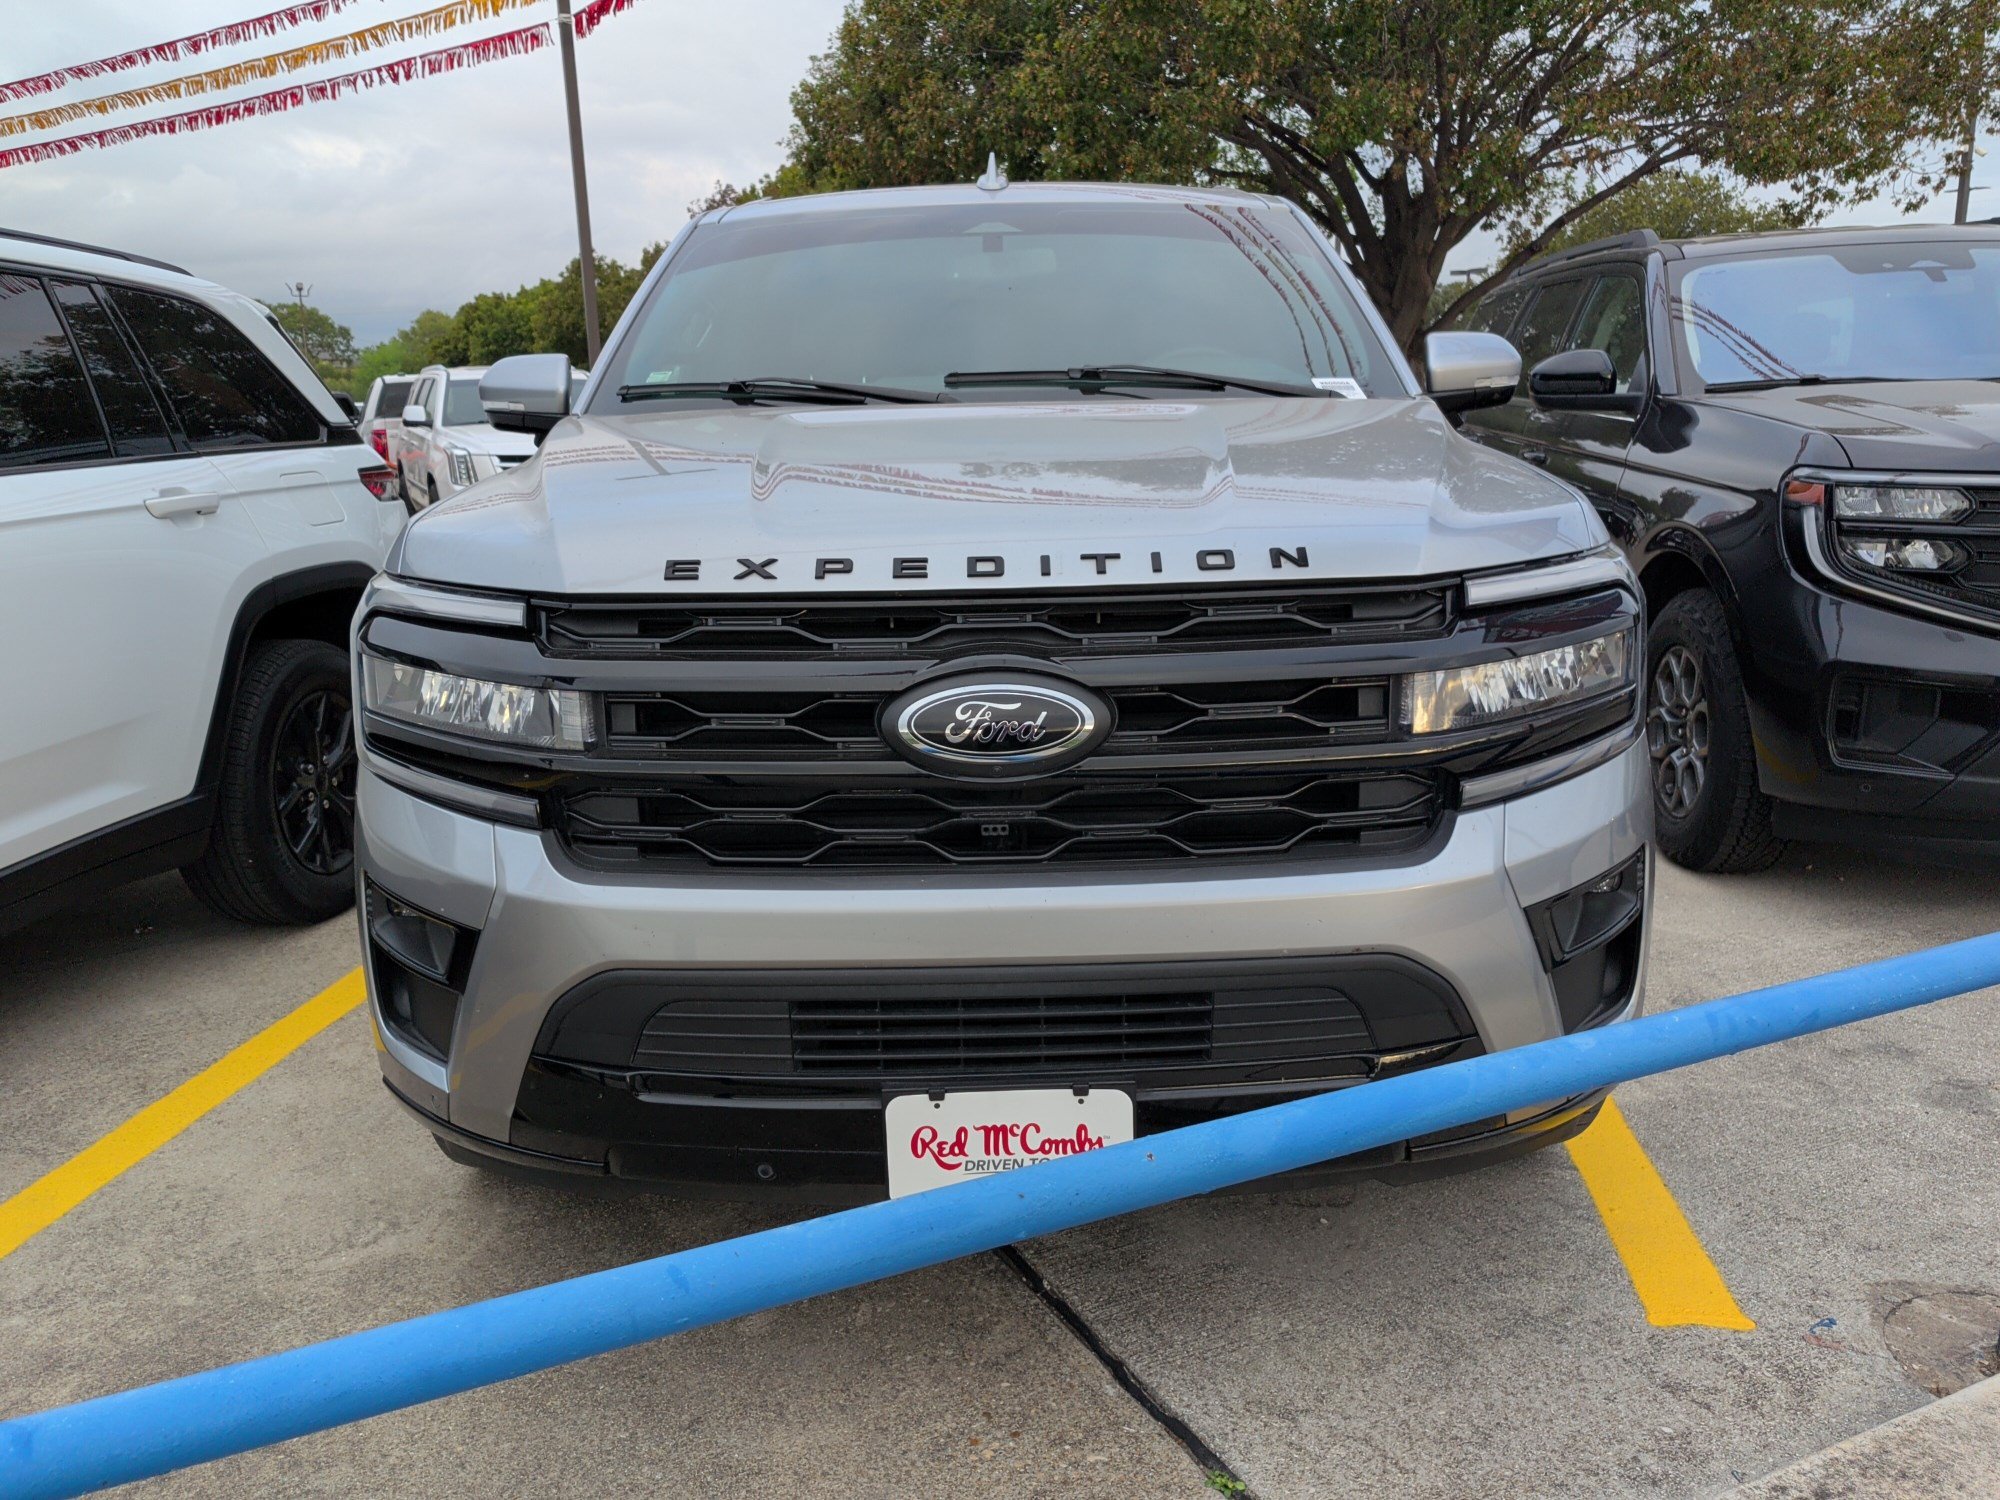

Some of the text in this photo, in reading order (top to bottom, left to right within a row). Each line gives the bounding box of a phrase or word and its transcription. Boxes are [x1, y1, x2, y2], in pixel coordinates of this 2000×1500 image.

[664, 547, 1309, 580] EXPEDITION
[945, 701, 1048, 744] Ford
[911, 1125, 969, 1171] Red
[973, 1123, 1104, 1156] McCombs
[964, 1158, 1024, 1172] DRIVEN
